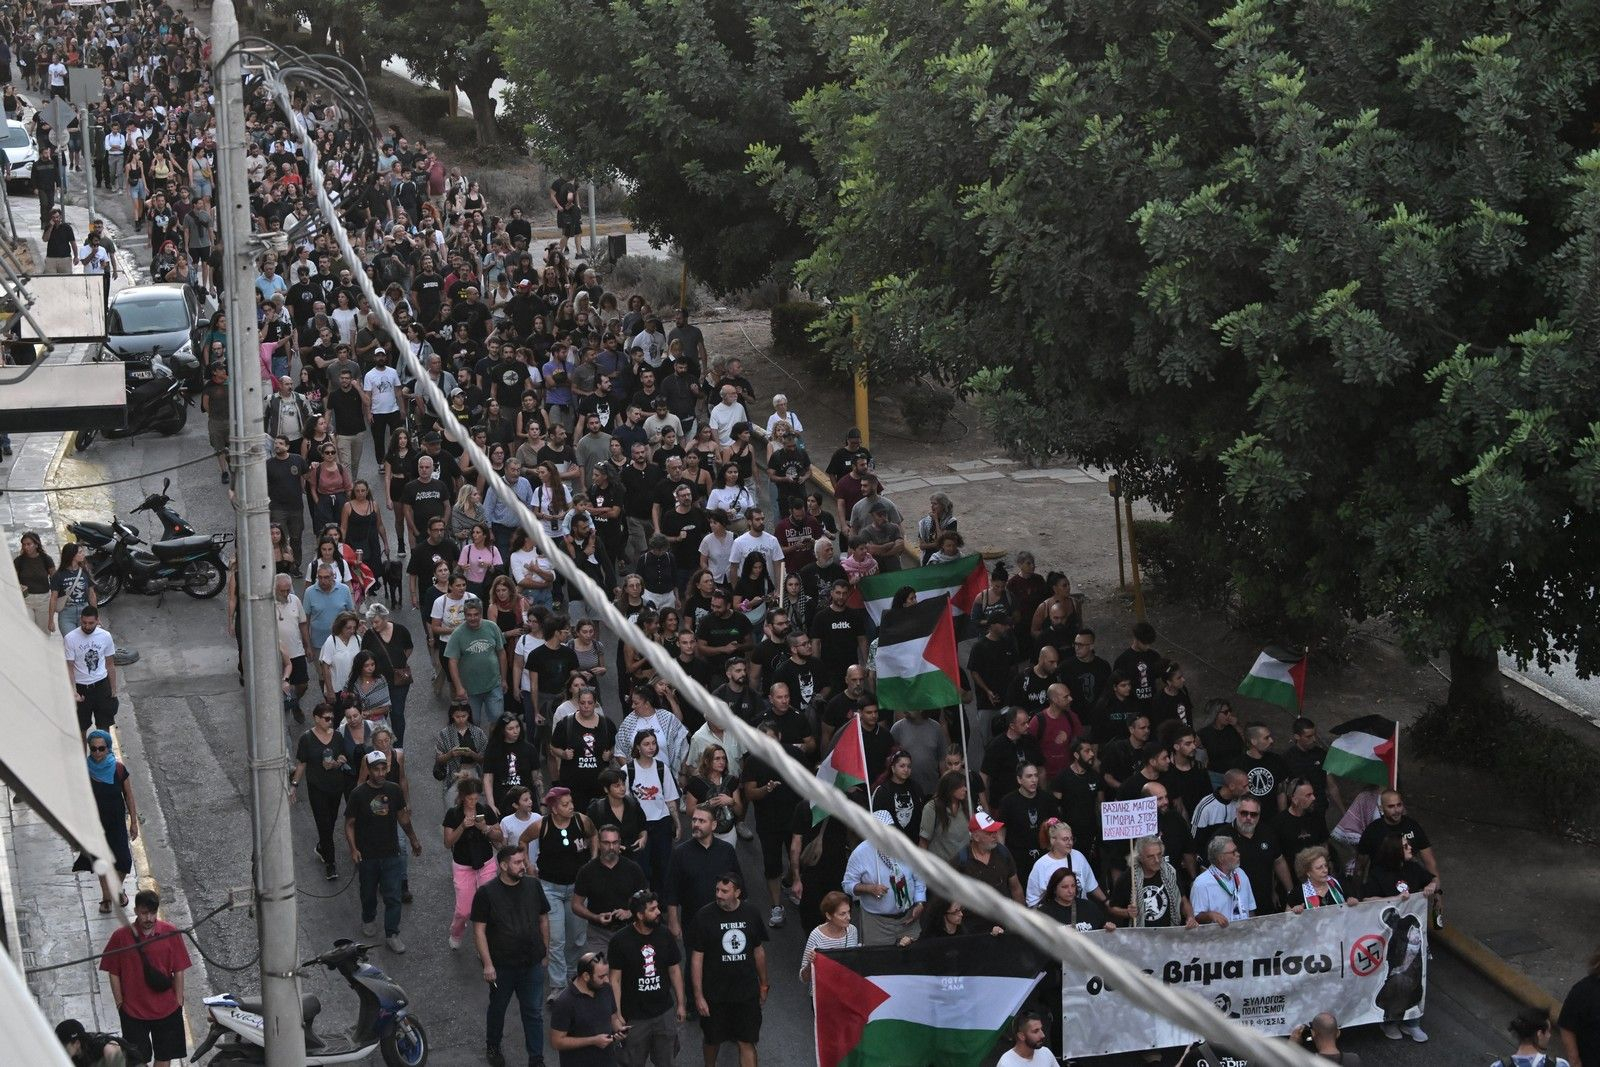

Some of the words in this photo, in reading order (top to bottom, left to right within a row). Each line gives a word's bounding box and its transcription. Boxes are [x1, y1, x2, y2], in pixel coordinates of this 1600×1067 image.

[720, 921, 747, 930] PUBLIC
[721, 953, 747, 962] ENEMY
[1163, 957, 1244, 986] βήμα
[1252, 950, 1333, 977] πίσω
[638, 975, 661, 985] ΠΟΤΕ
[638, 982, 661, 991] ΞΑΝΑ
[1242, 994, 1286, 1007] ΣΥΛΛΟΓΟΣ
[1242, 1004, 1285, 1016] ΠΟΛΙΤΙΣΜΟΥ
[1256, 1017, 1286, 1026] ΦΥΣΣΑΣ
